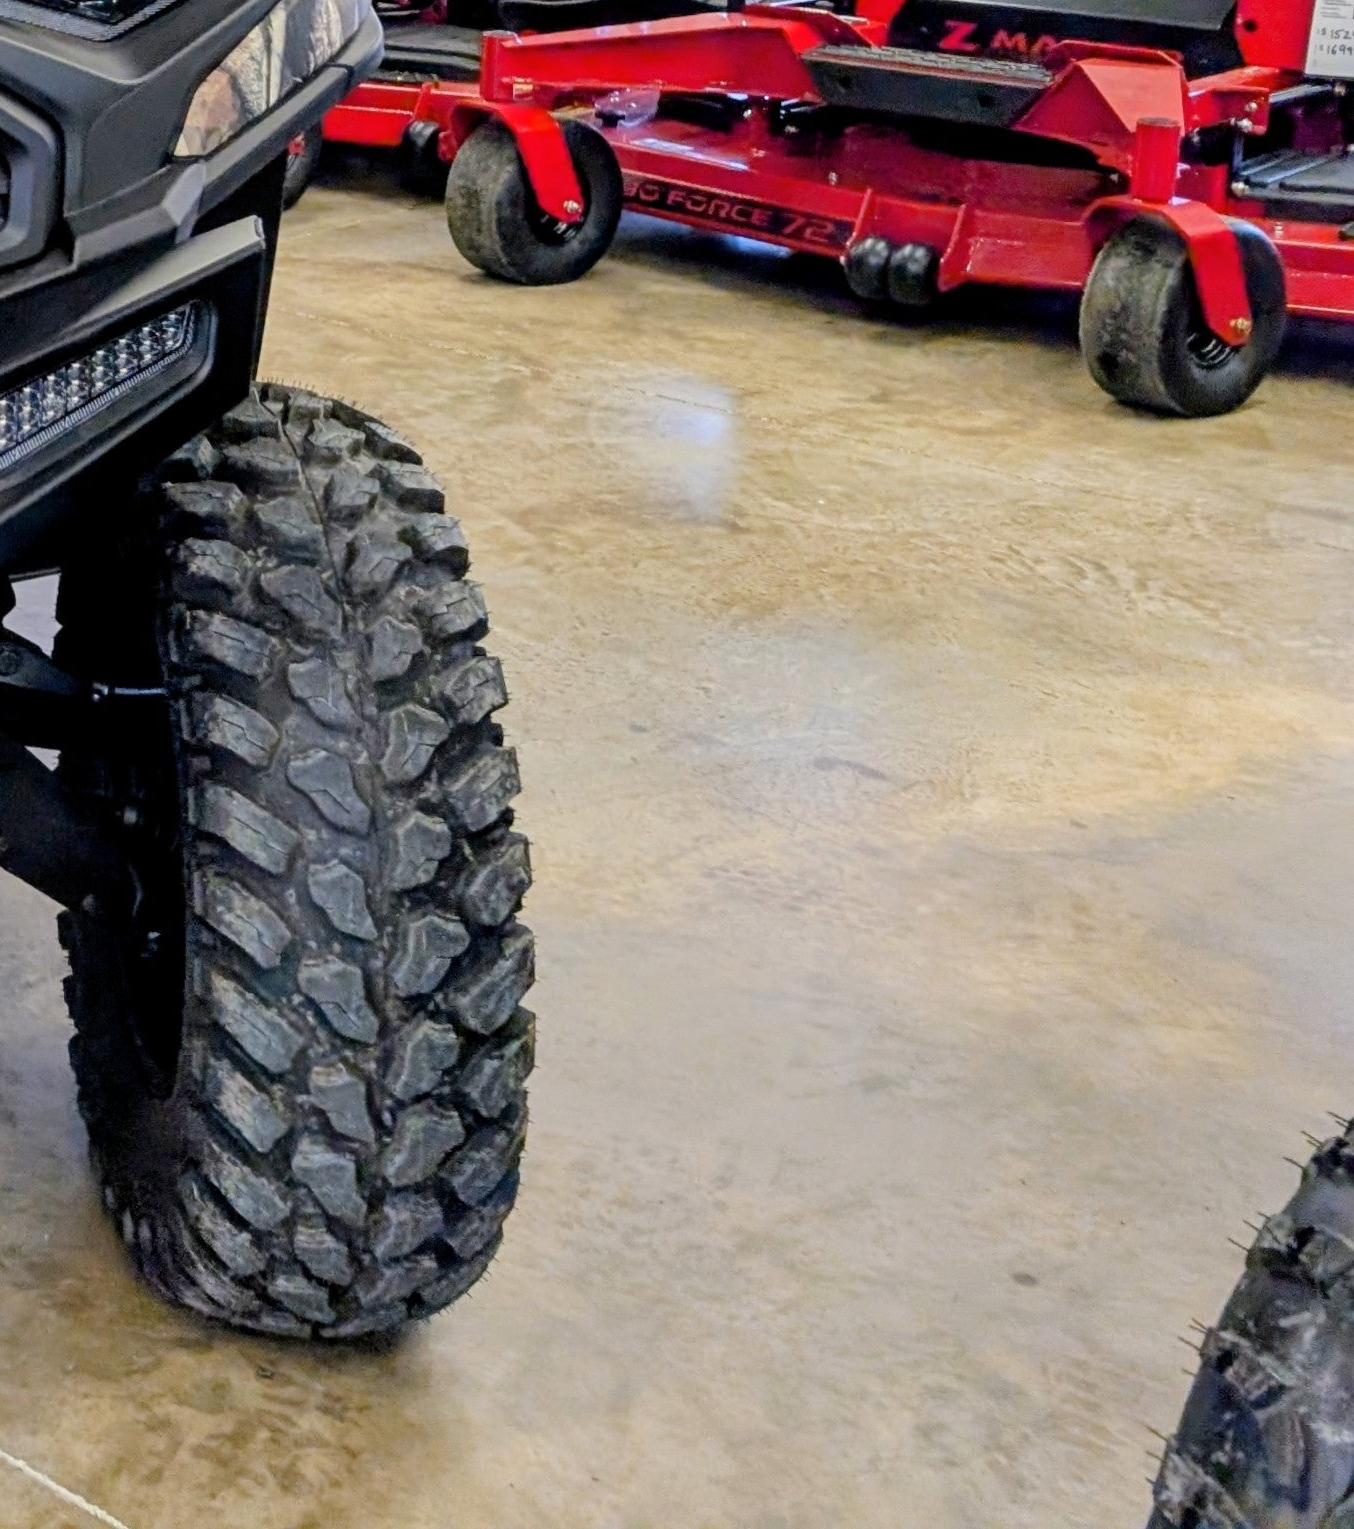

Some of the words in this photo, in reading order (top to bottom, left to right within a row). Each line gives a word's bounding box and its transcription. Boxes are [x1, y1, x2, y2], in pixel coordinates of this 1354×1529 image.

[939, 19, 978, 51] Z
[666, 190, 773, 225] FORCE
[783, 213, 836, 243] 72
